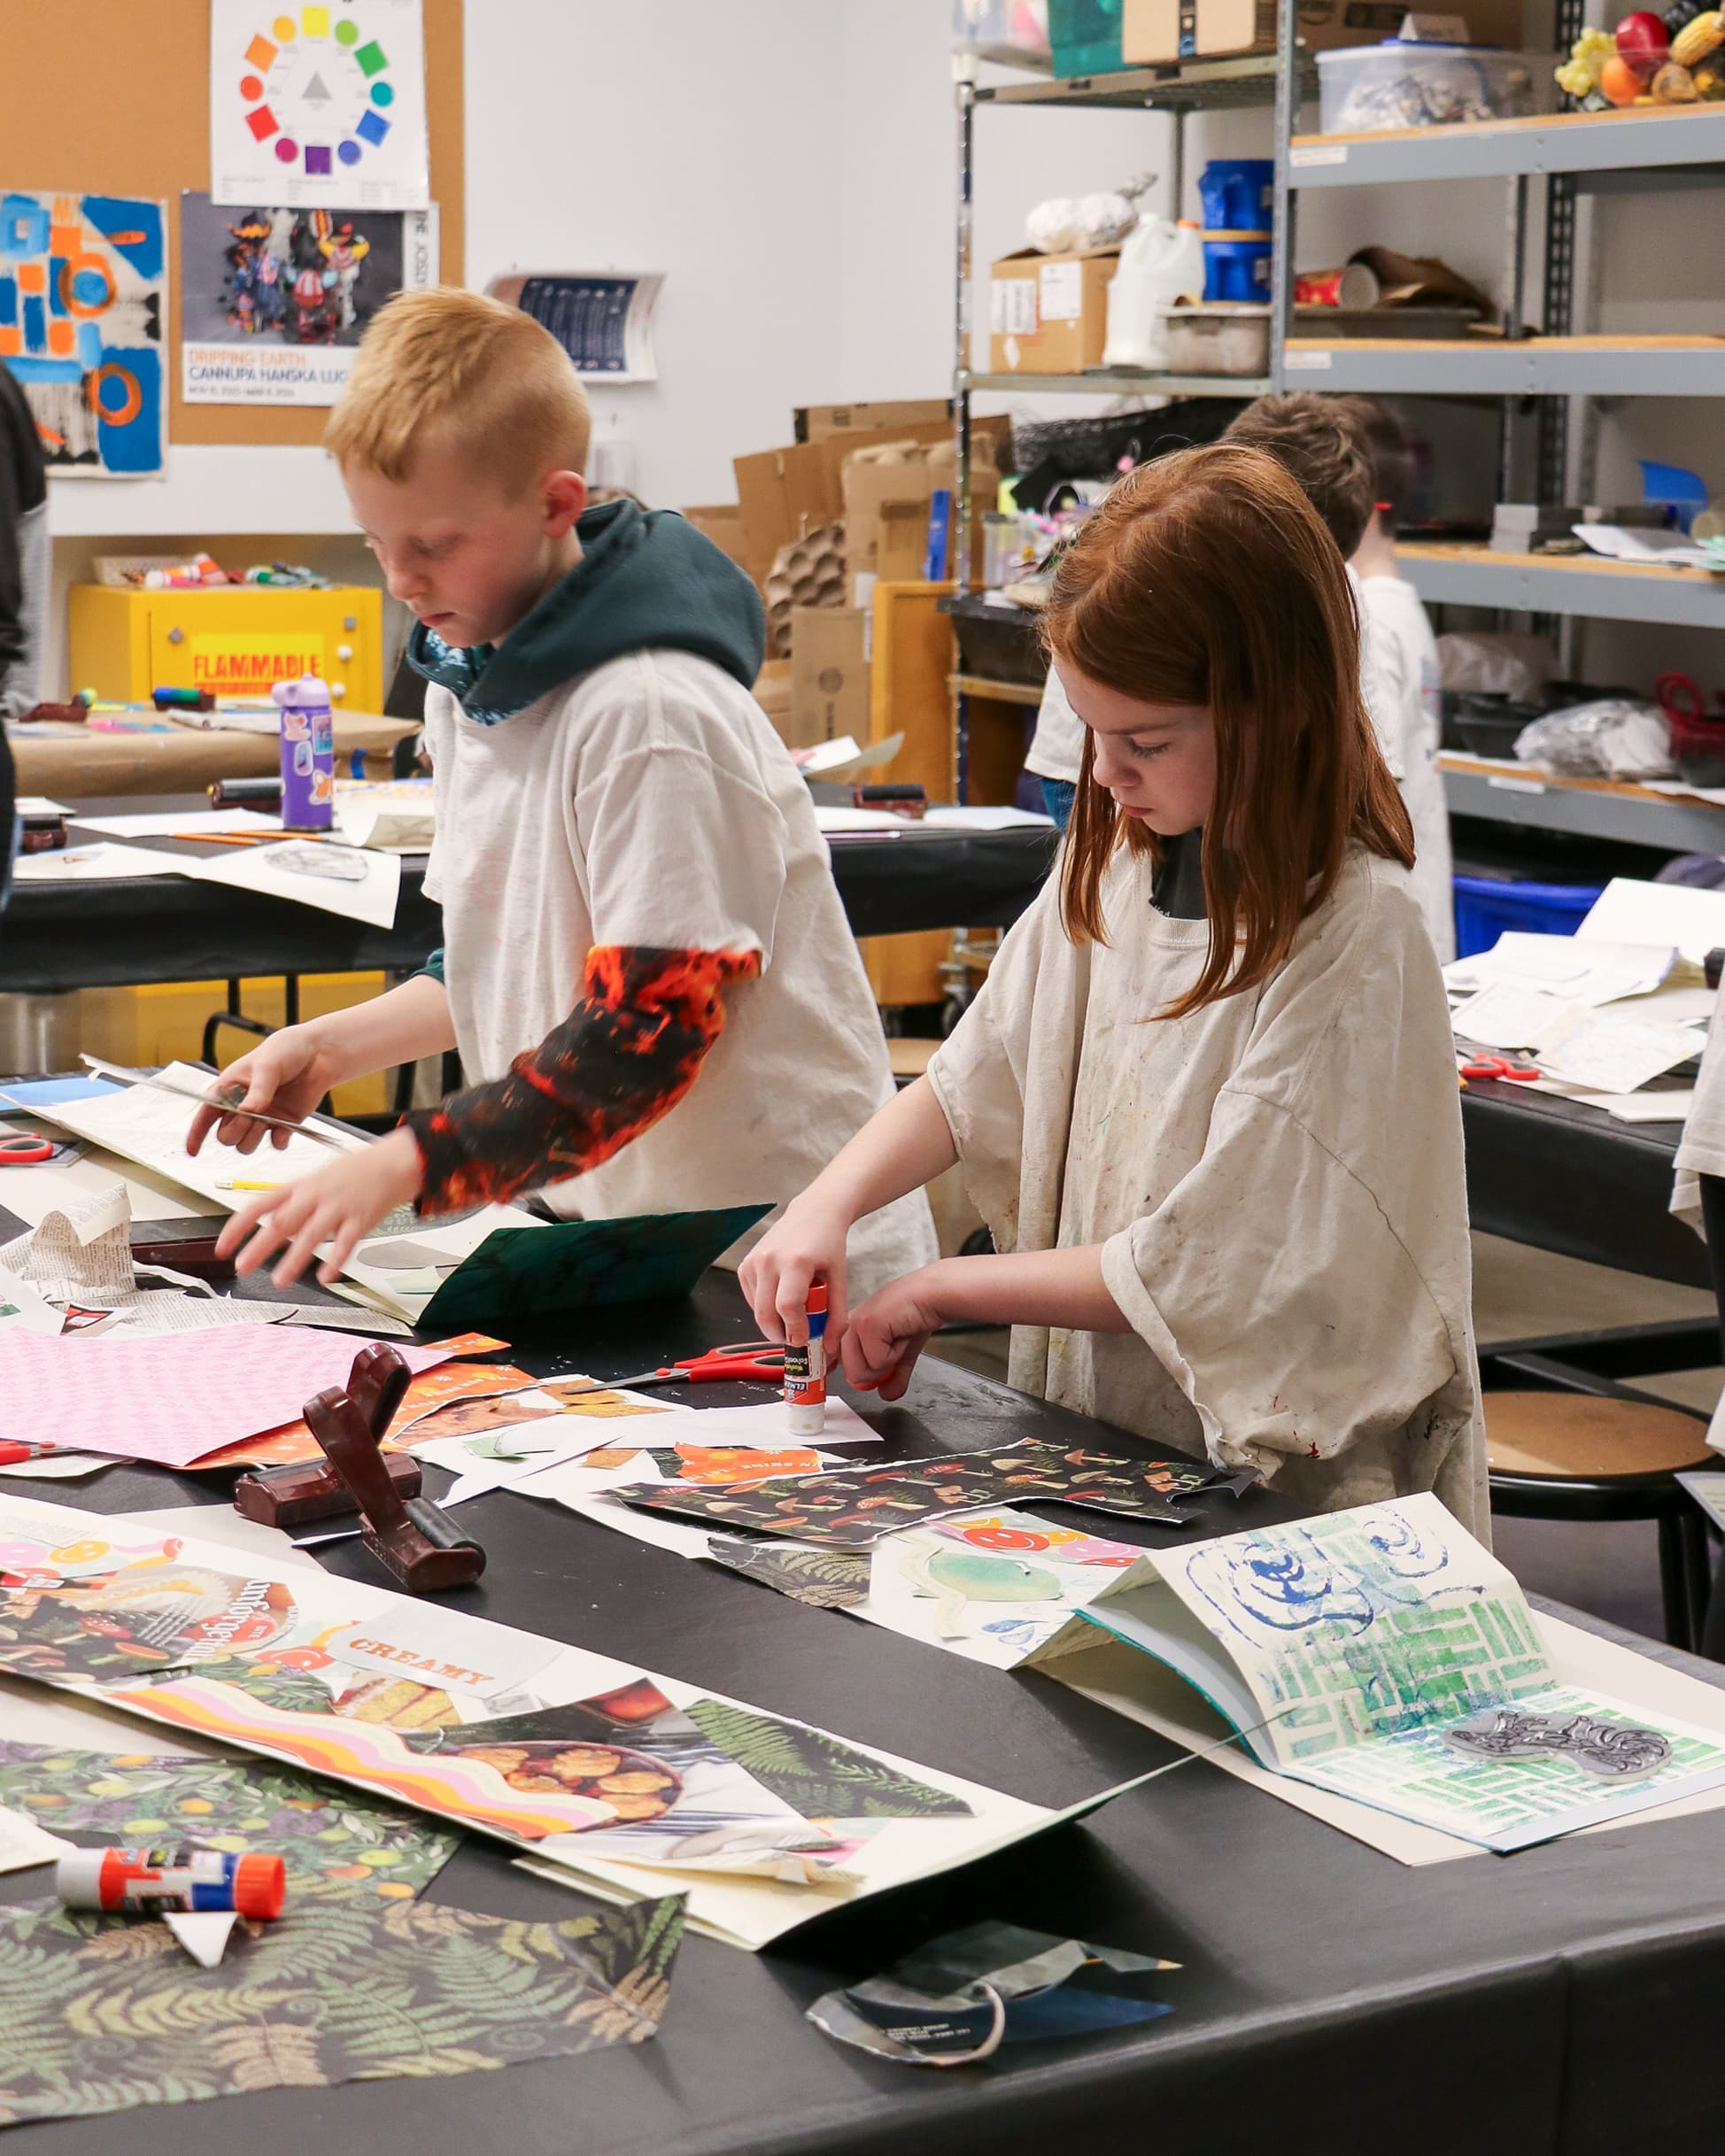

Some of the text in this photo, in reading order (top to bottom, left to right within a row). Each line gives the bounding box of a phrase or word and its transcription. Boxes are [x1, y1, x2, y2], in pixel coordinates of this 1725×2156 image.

[190, 366, 256, 382] CANNUPA
[261, 367, 317, 383] HANSKA
[194, 653, 321, 679] FLAMMABLE
[349, 1638, 496, 1686] CREAMY
